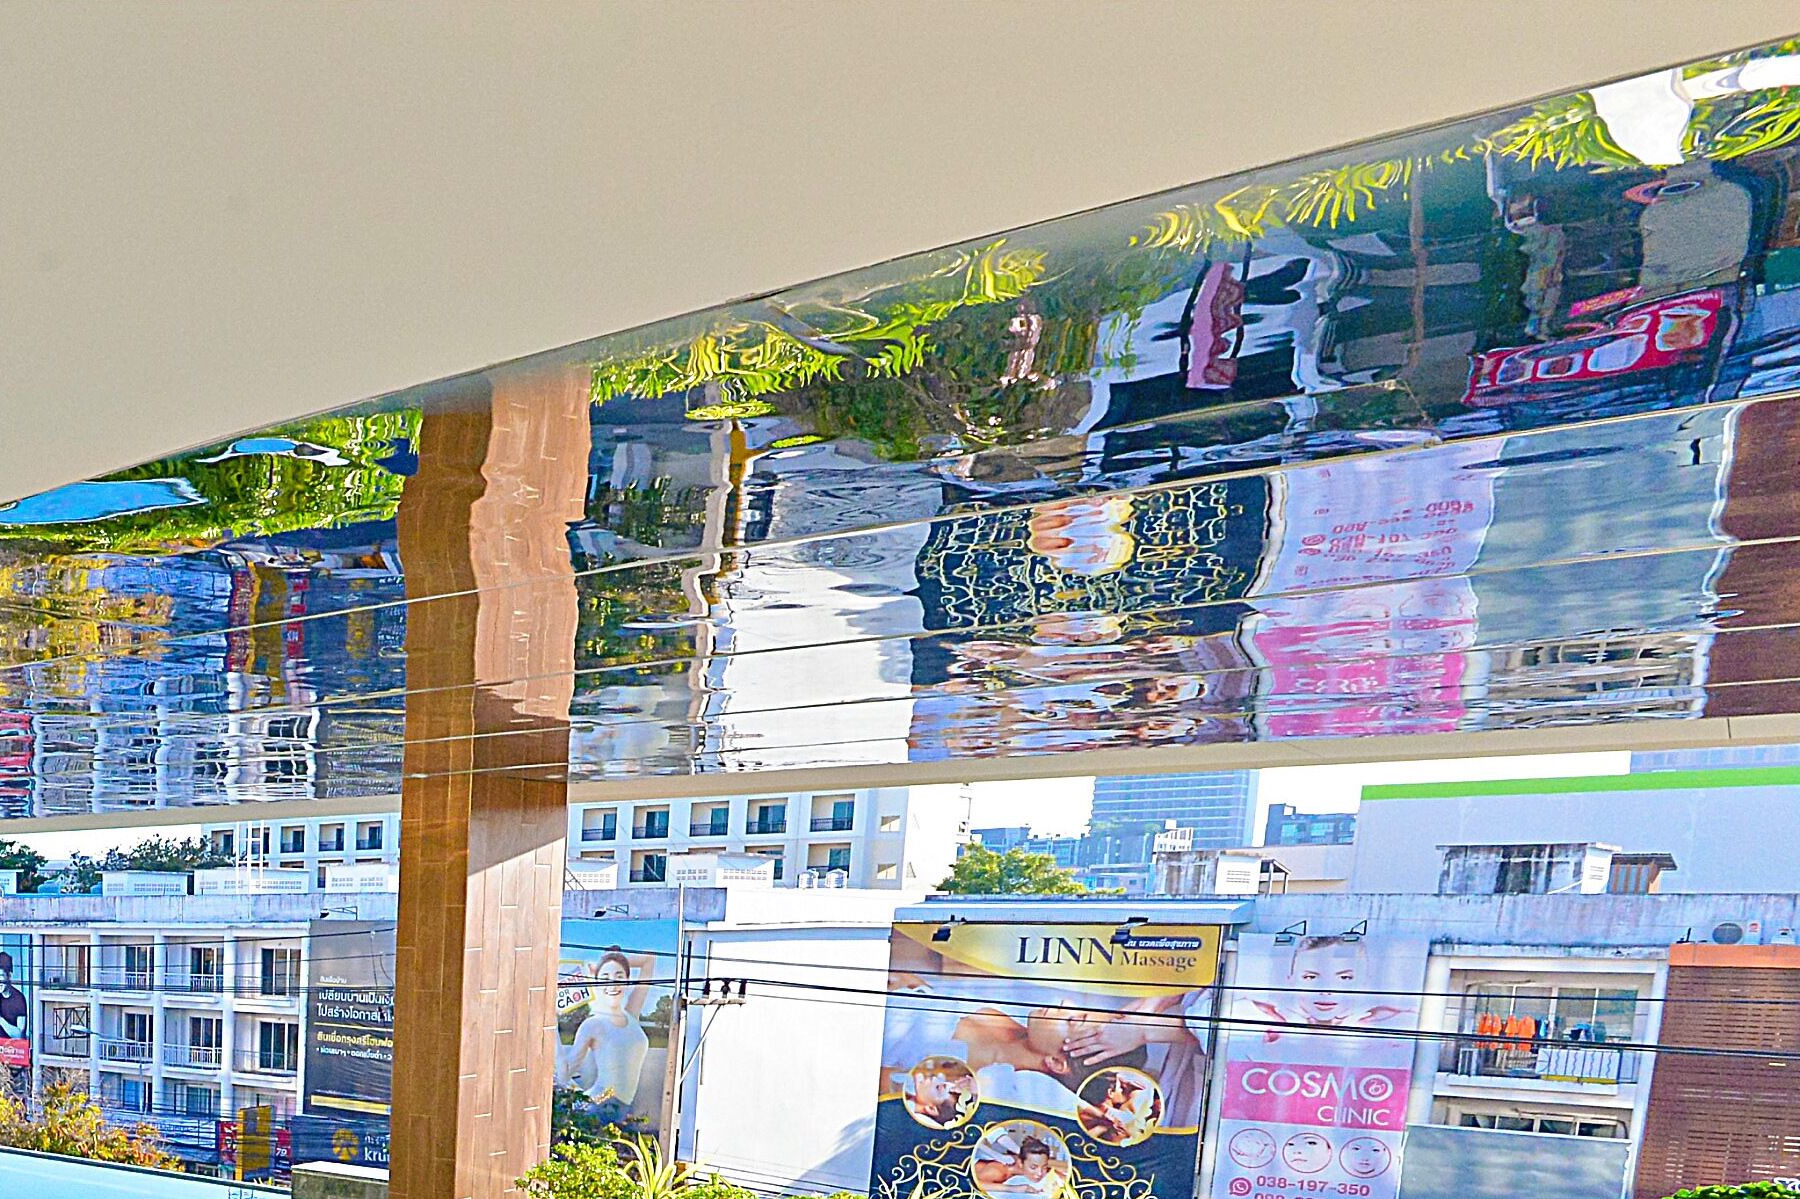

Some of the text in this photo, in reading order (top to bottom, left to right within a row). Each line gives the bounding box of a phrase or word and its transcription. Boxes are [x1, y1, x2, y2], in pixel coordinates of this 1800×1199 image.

[1016, 936, 1115, 965] LINN
[1120, 951, 1197, 973] Massage
[1241, 1067, 1394, 1102] COSMO
[1256, 1175, 1371, 1197] 038-197-350
